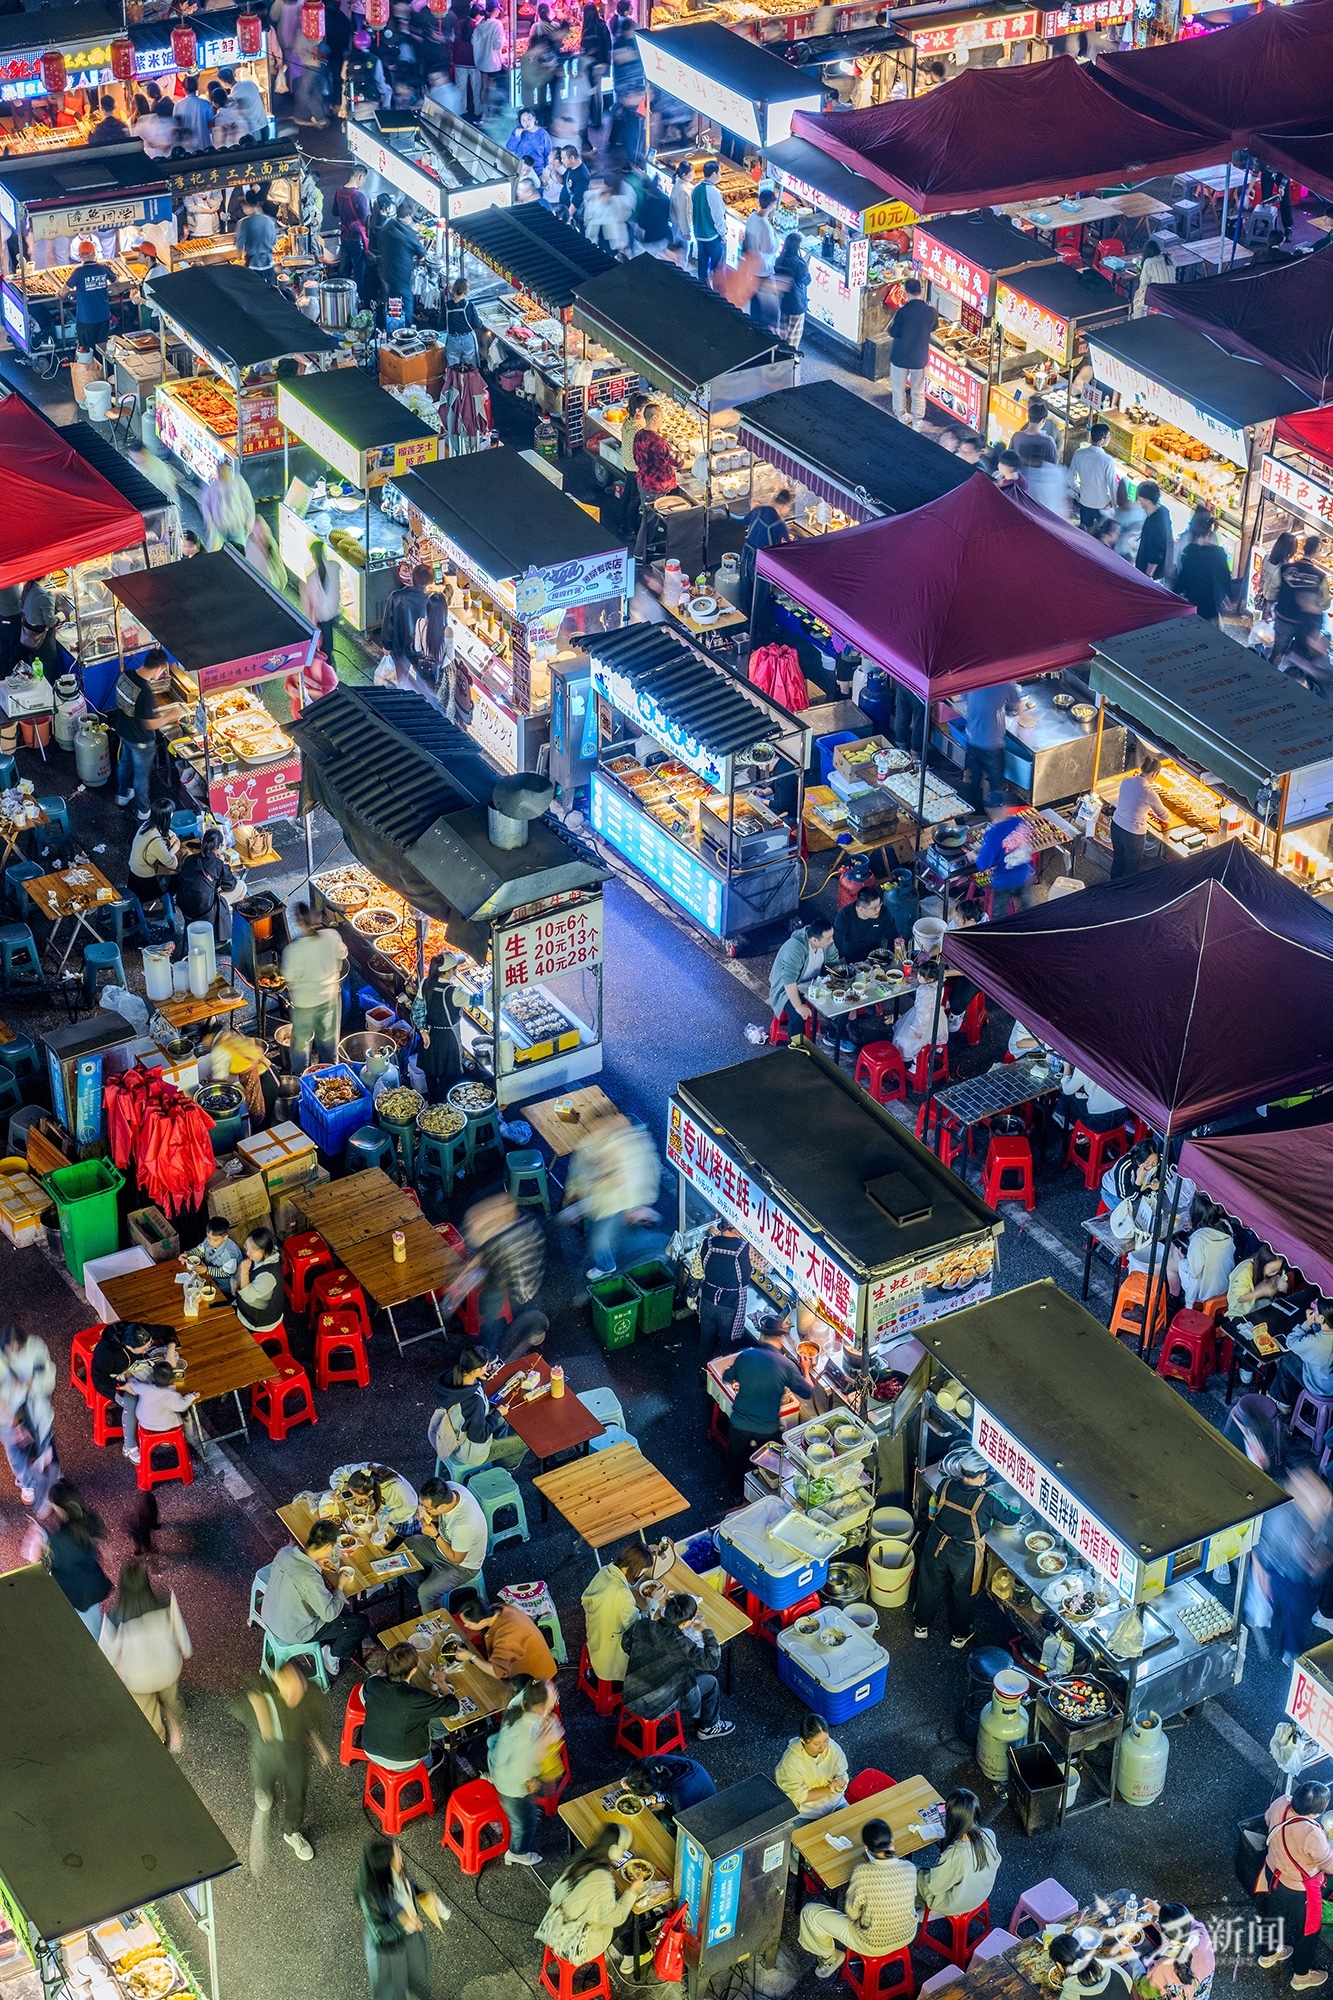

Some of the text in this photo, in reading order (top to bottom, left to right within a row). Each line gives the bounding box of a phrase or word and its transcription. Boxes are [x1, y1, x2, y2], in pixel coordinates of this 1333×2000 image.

[933, 15, 1028, 49] 状元烤猪蹄
[917, 237, 982, 295] 老成都烤兔
[534, 927, 600, 961] 20元13个
[535, 913, 589, 942] 10元6个
[504, 933, 529, 989] 生蚝
[534, 945, 600, 977] 40元28个
[871, 1274, 913, 1302] 生蚝
[874, 1313, 927, 1343] 男人的加油站
[978, 1418, 1120, 1580] 皮蛋鲜肉馄饨 南昌拌粉 拇指煎包
